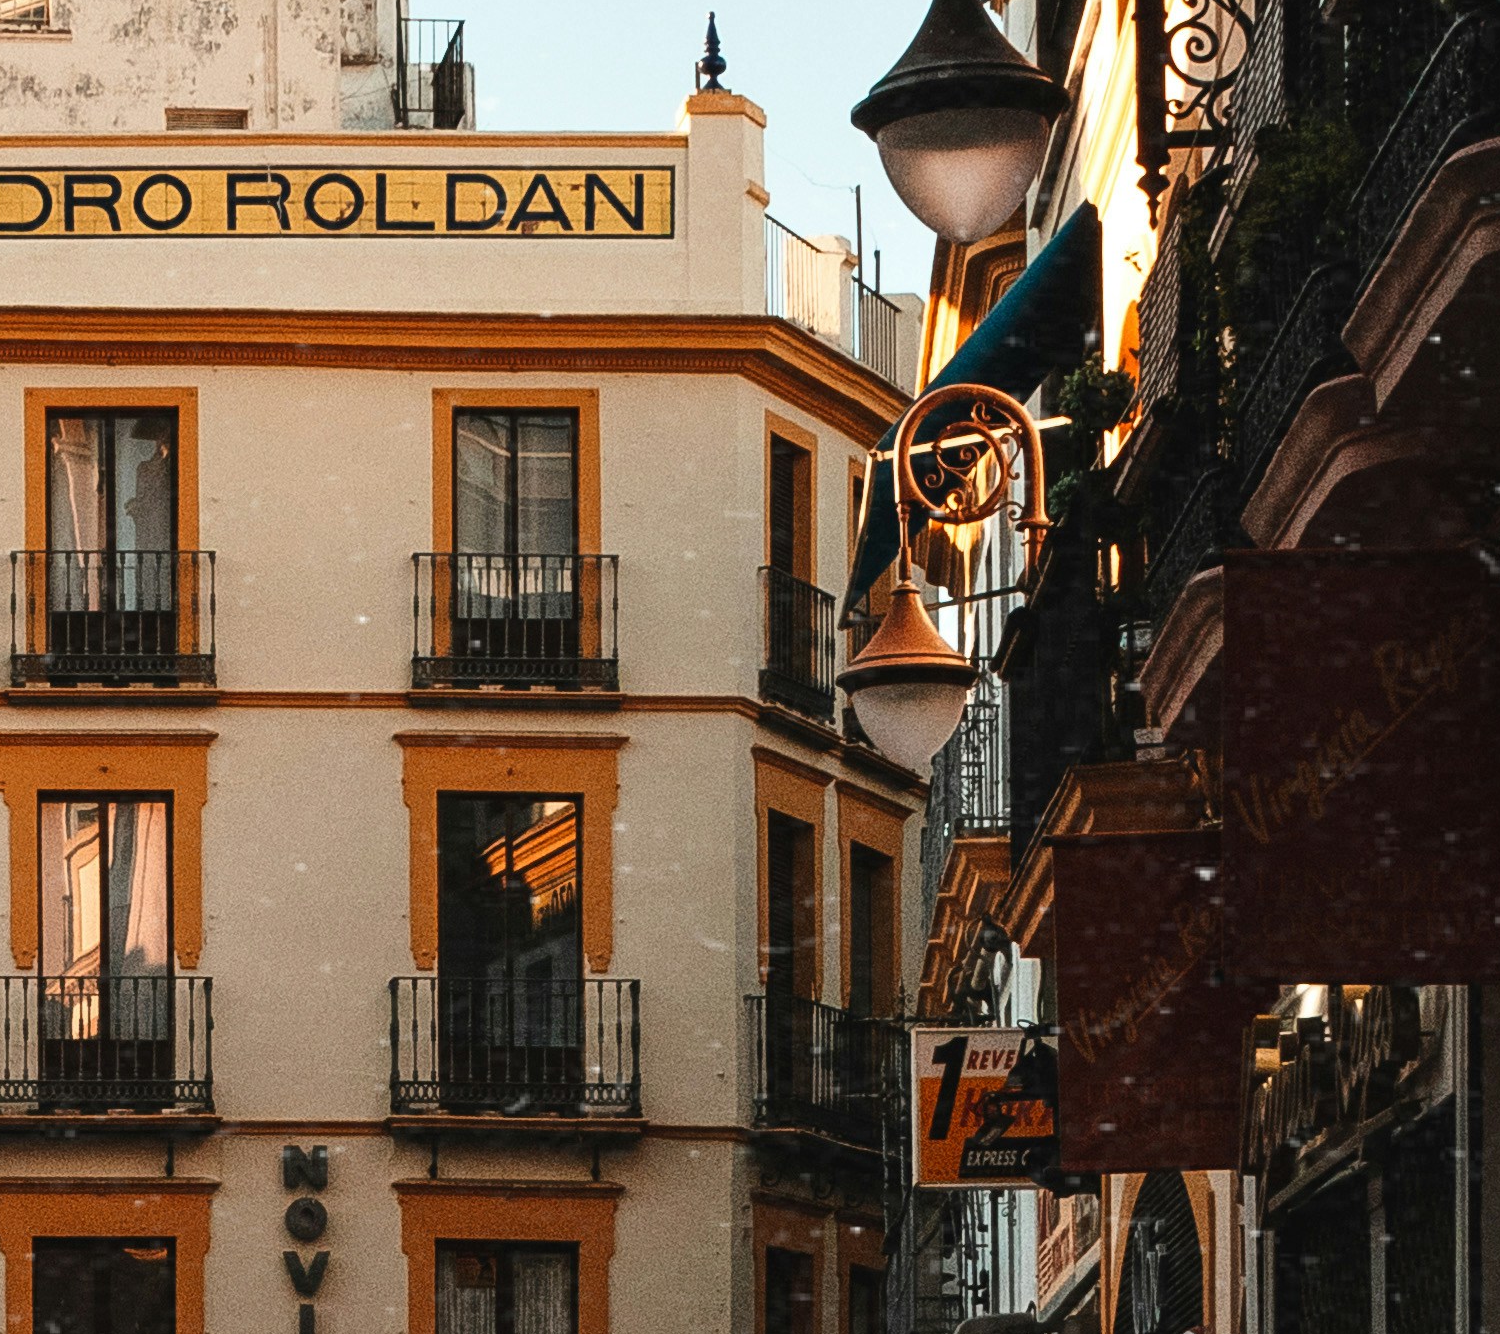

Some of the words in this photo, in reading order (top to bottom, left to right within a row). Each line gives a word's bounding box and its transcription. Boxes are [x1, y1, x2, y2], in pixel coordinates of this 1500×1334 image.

[226, 173, 645, 232] ROLDAN
[928, 1036, 968, 1140] 1
[967, 1050, 1015, 1070] REVE
[967, 1150, 1017, 1167] EXPRESS
